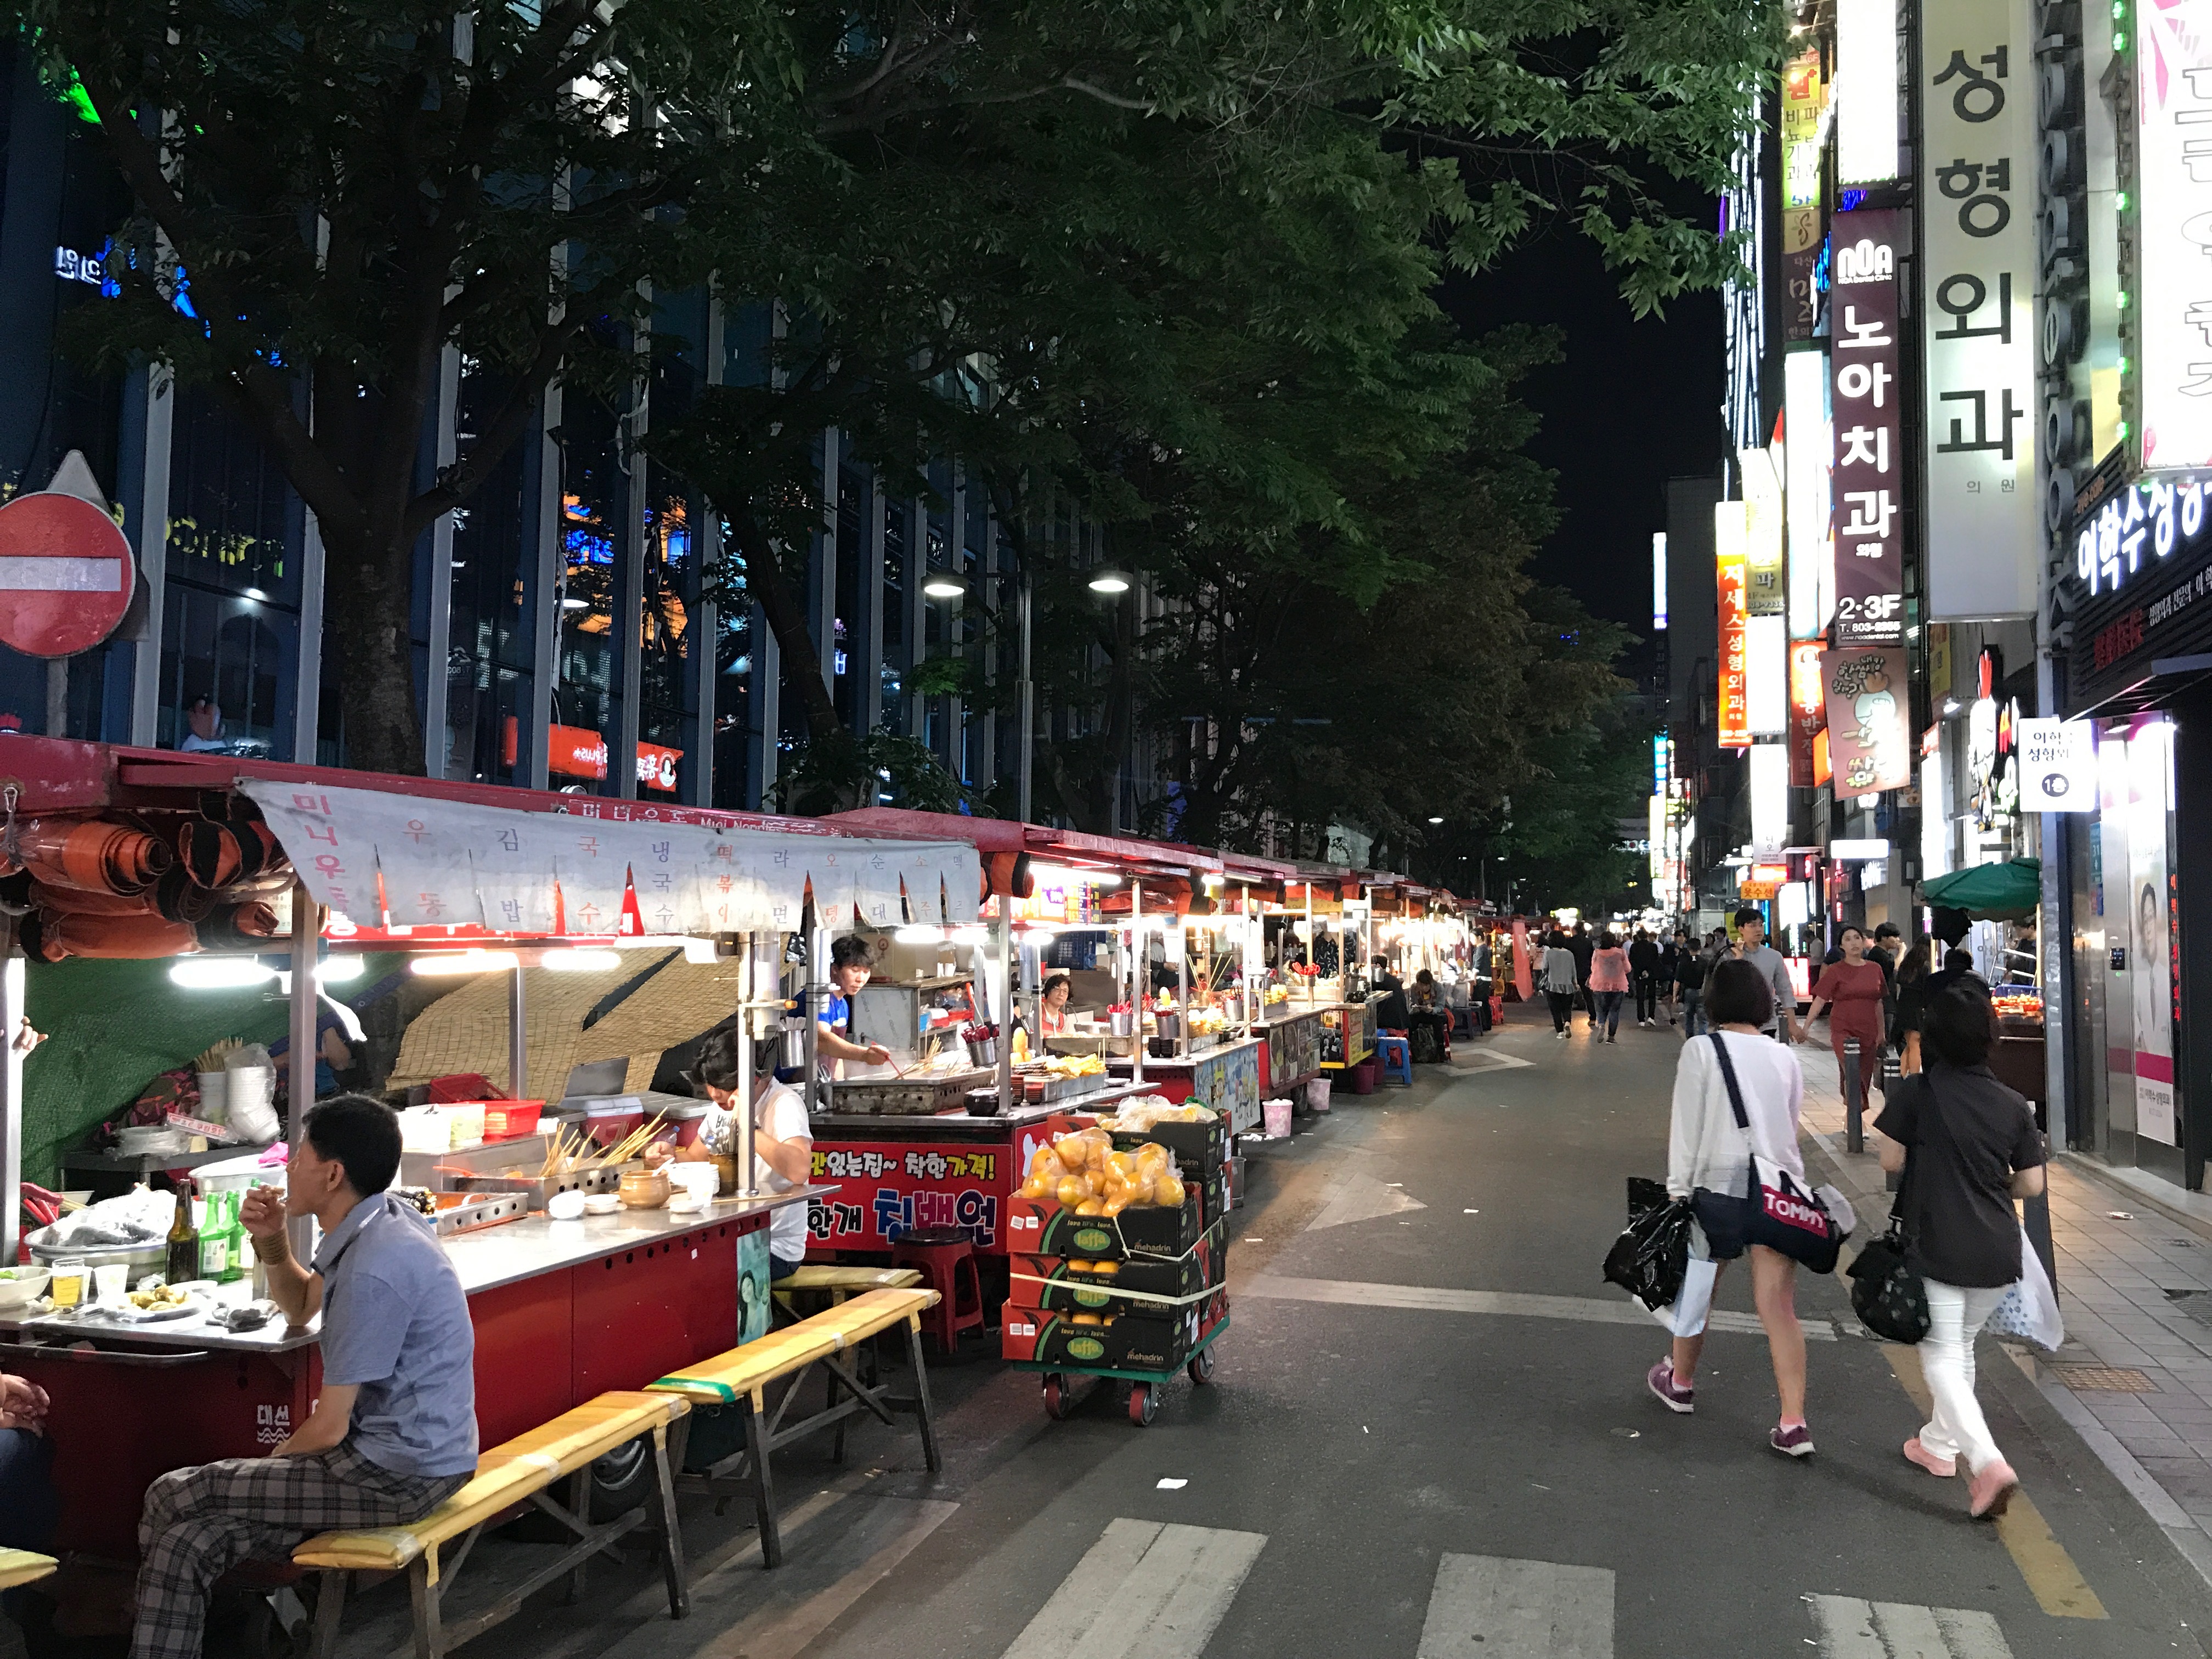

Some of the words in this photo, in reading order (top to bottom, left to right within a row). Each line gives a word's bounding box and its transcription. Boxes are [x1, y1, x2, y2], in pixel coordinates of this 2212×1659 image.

[1933, 45, 2024, 460] 성형외과
[1837, 305, 1898, 539] 노아치과
[1966, 478, 2016, 494] 의원
[401, 819, 447, 917] 우동
[495, 827, 524, 923] 김밥
[577, 836, 601, 926] 국수
[651, 840, 675, 925] 냉국수
[716, 844, 734, 923] 떡볶이
[772, 849, 790, 924] 라면
[825, 853, 840, 923] 오뎅
[871, 853, 887, 921] 순대
[915, 855, 933, 918] 소주
[1743, 887, 1773, 898] 옷수선
[257, 1404, 290, 1426] 대선
